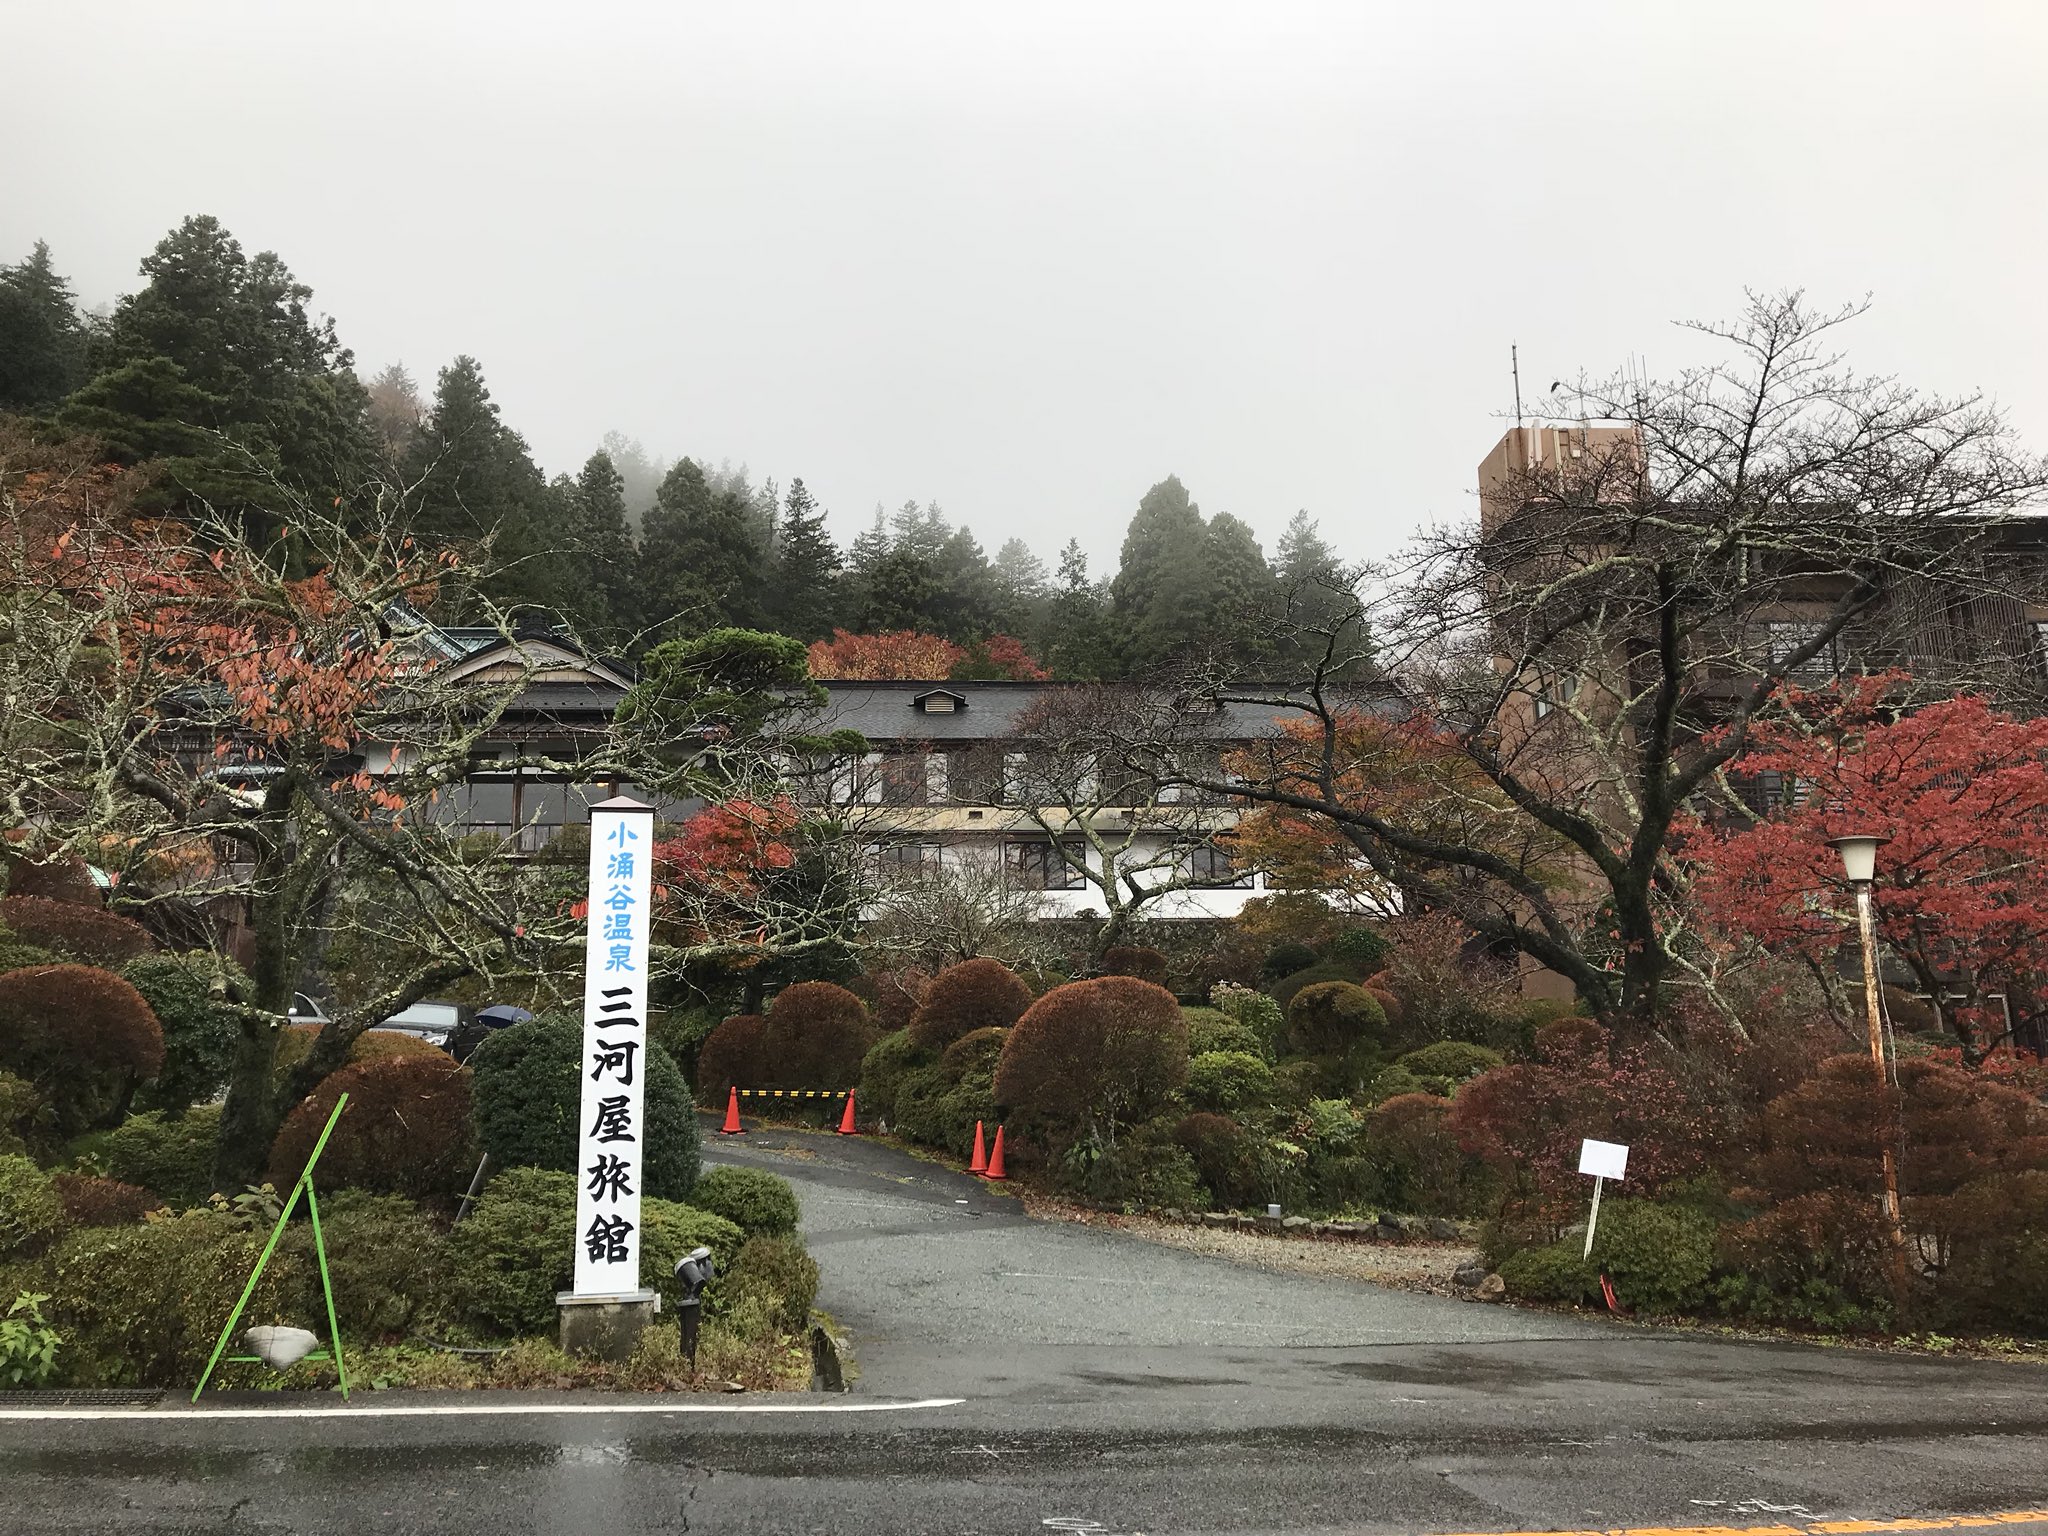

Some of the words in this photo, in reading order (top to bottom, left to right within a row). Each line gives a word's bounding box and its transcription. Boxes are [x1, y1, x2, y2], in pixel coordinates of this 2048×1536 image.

[603, 821, 638, 972] 小涌谷温泉
